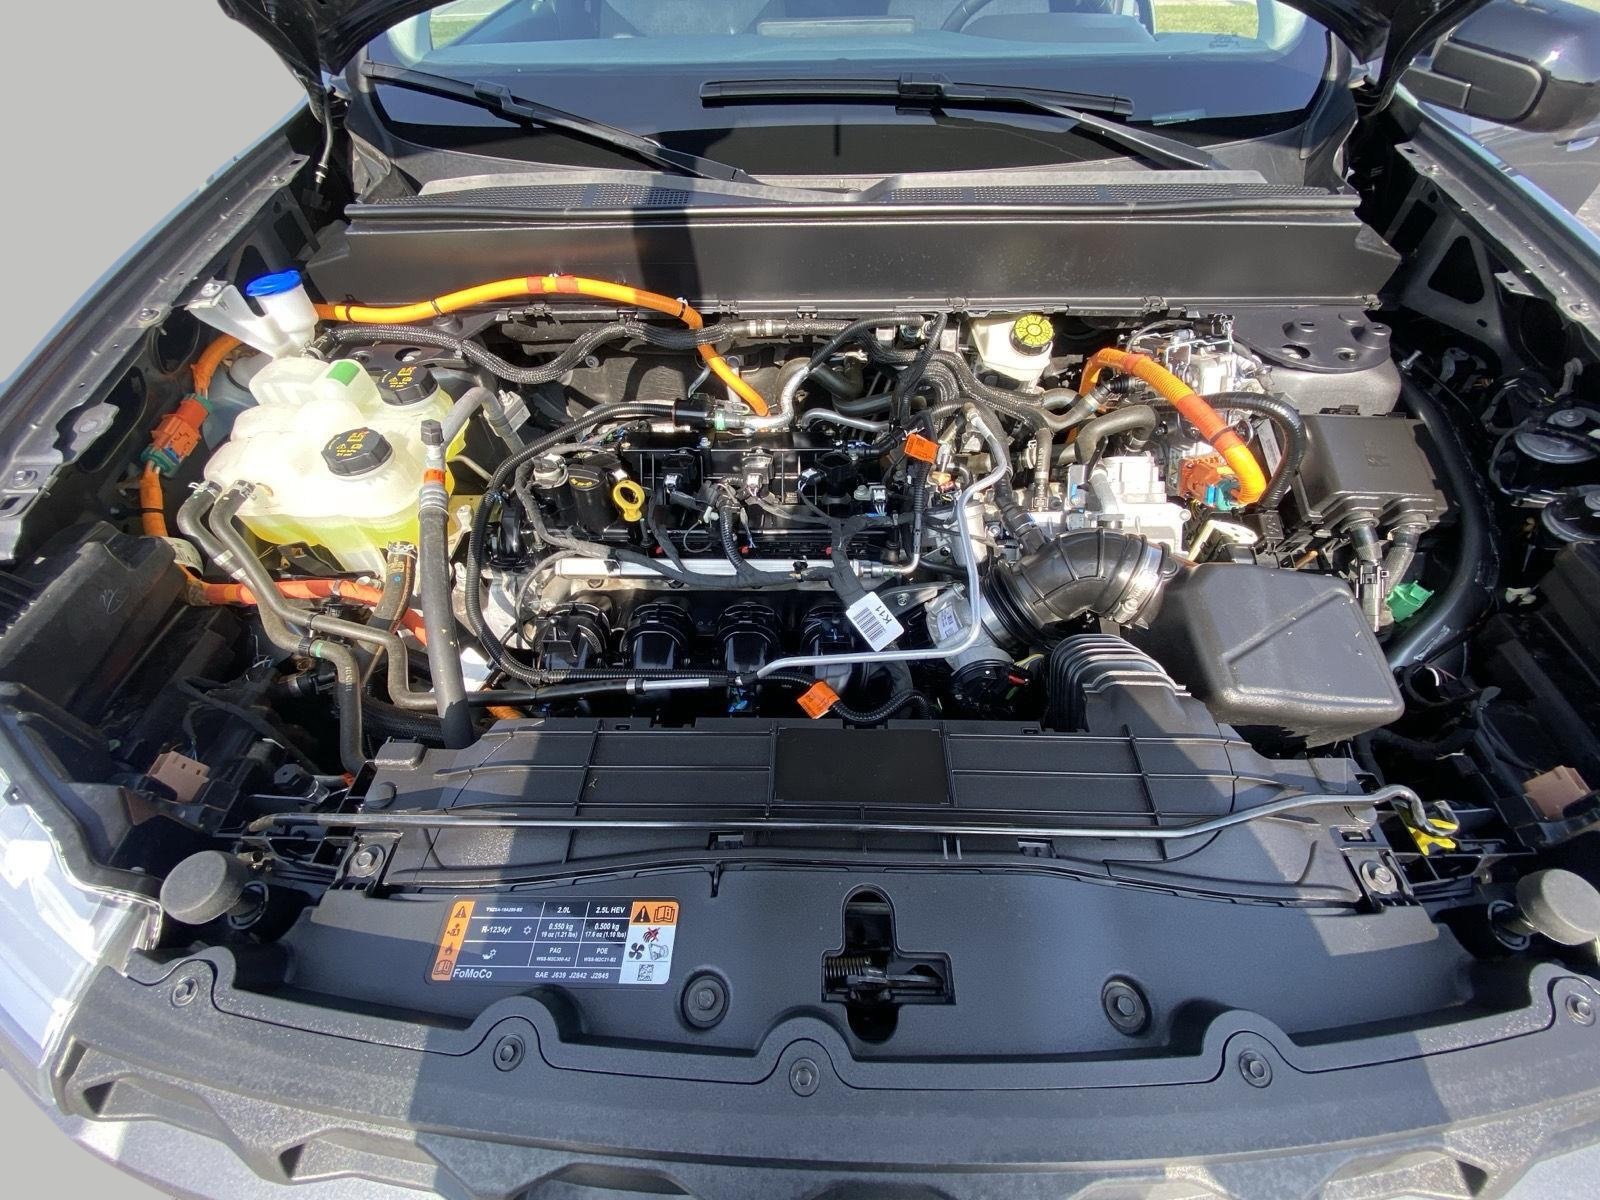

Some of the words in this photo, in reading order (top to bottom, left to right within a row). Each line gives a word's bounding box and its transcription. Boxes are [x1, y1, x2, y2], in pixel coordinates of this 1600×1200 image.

[875, 605, 892, 624] K11
[596, 906, 610, 914] 2.5L
[481, 926, 512, 935] R-1234yf
[566, 923, 574, 932] kg
[612, 923, 620, 932] kg
[453, 968, 492, 978] FoMoCo
